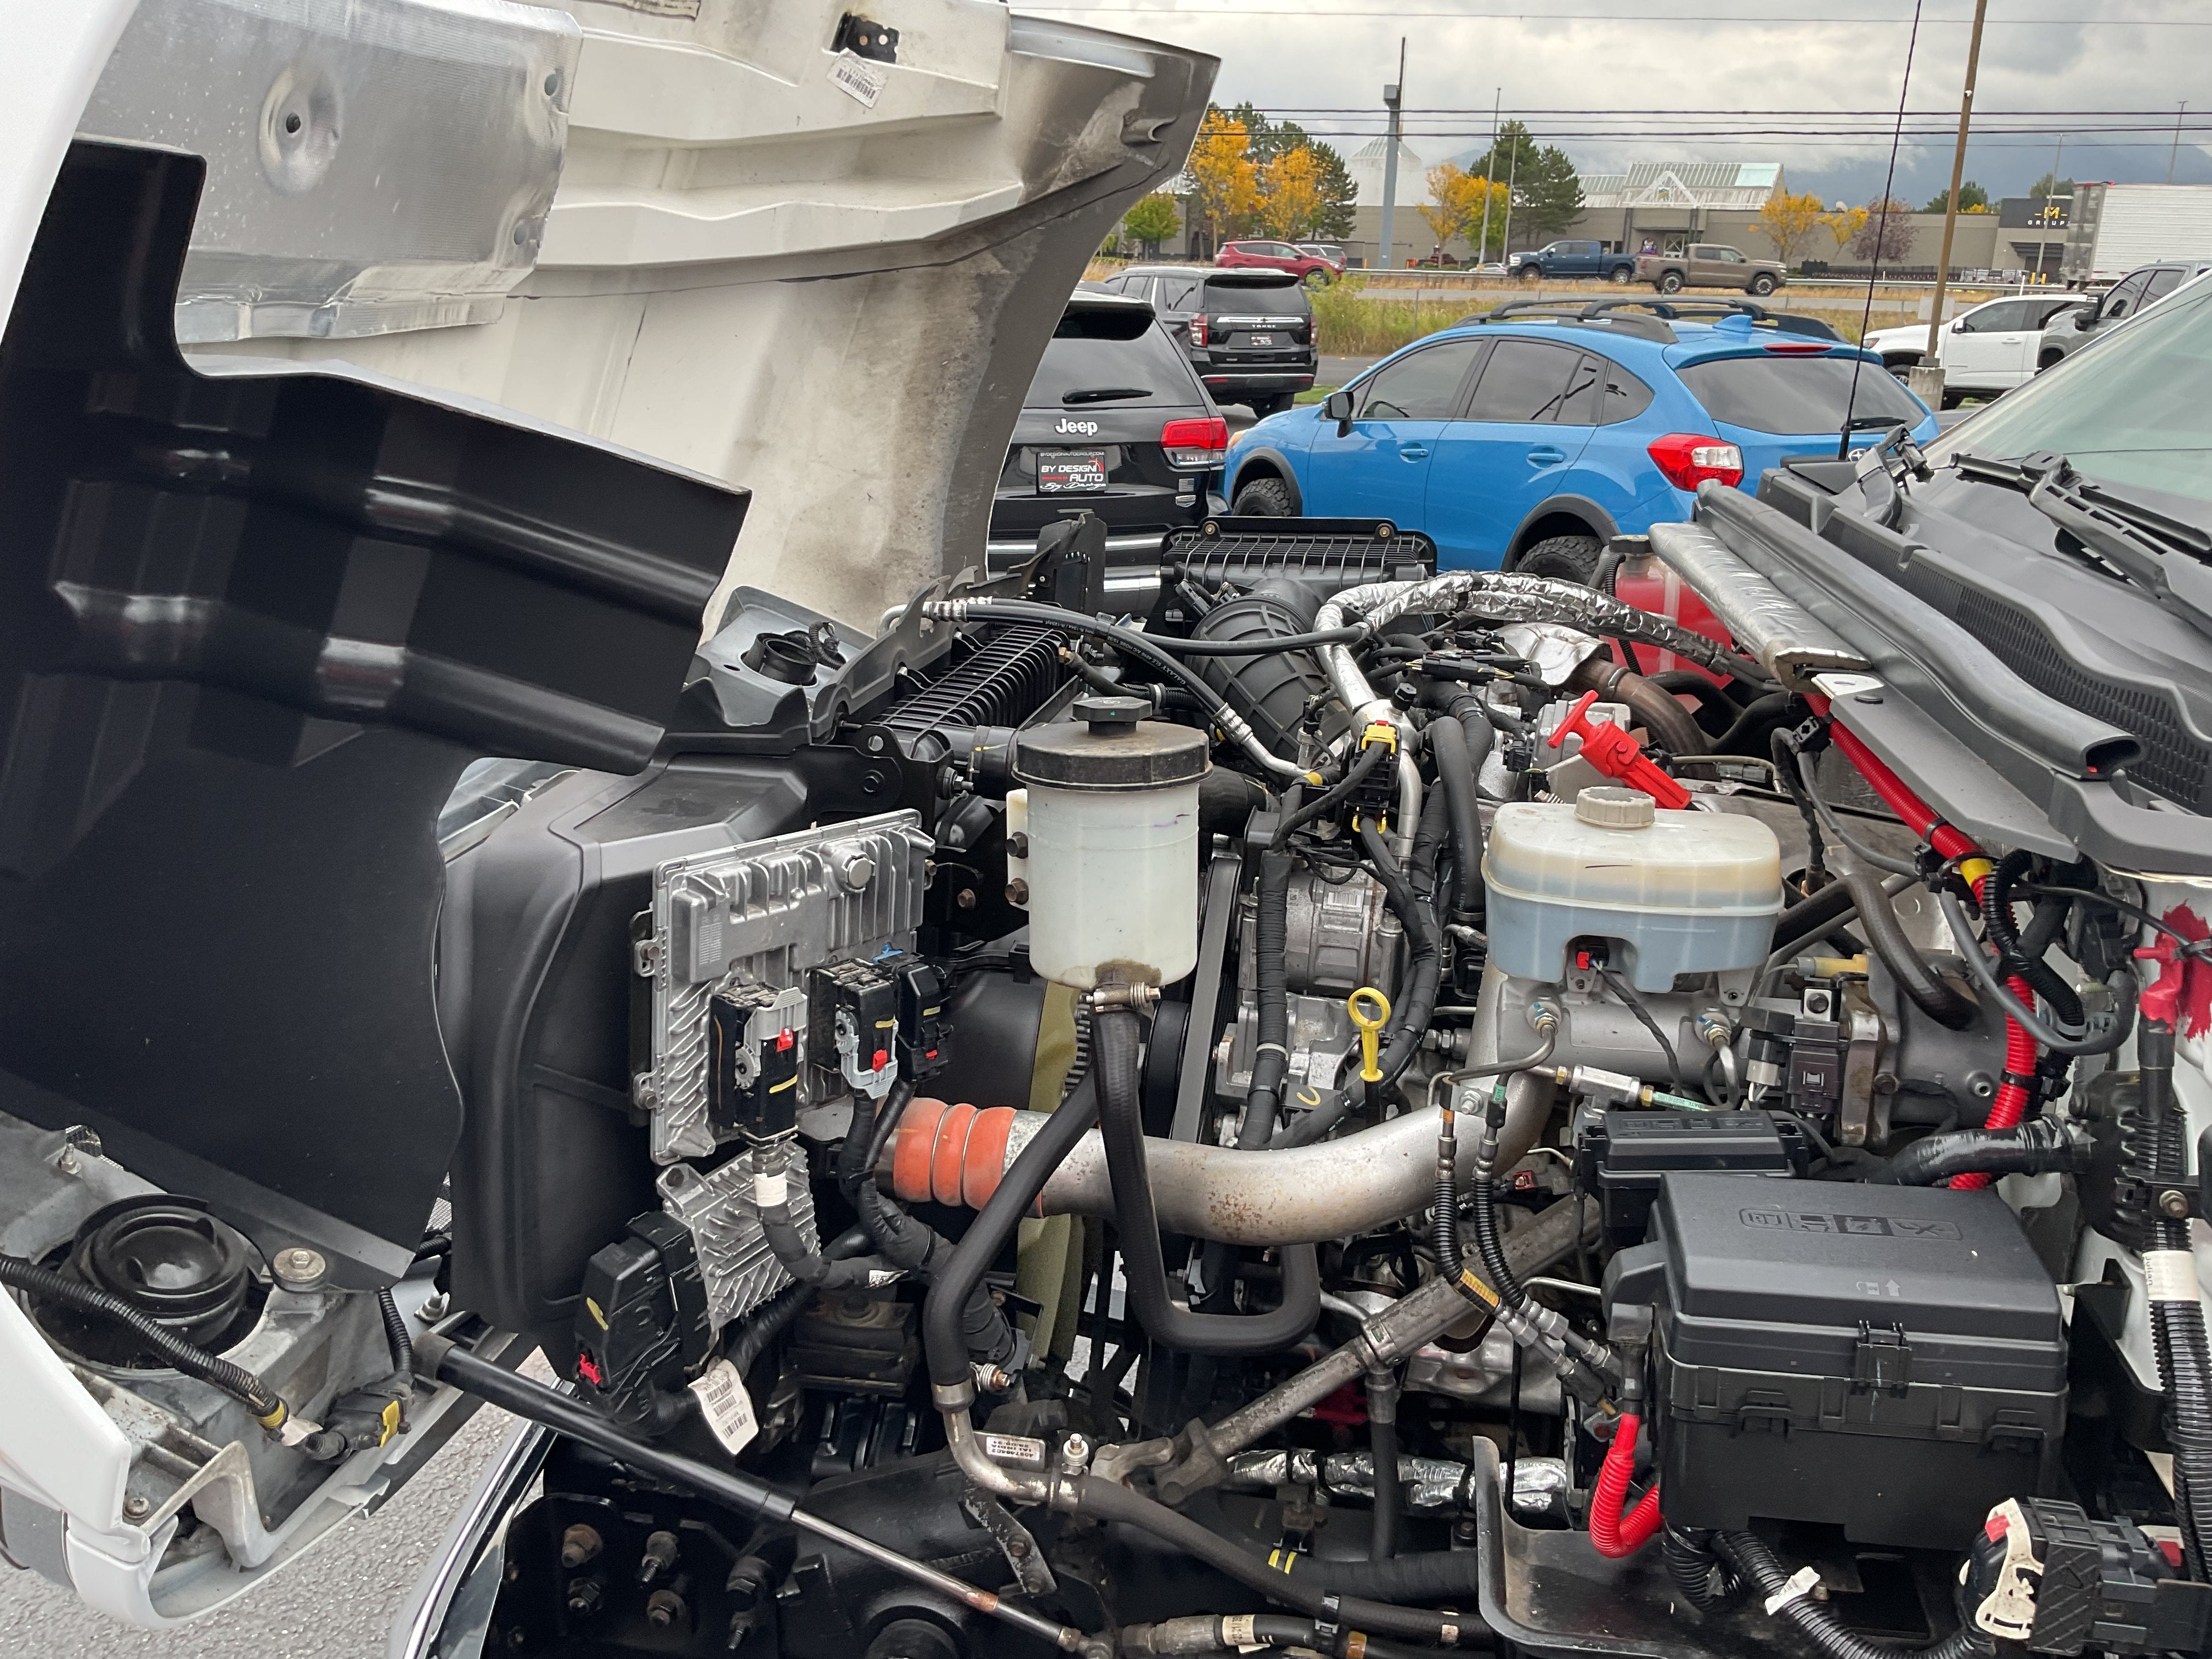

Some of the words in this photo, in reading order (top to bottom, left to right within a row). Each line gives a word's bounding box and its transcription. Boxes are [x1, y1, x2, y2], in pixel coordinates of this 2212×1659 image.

[1055, 417, 1098, 437] Jeep
[1069, 473, 1103, 482] AUTO
[1120, 641, 1133, 650] HOSE
[1152, 658, 1162, 667] SLE
[1163, 665, 1186, 685] GALAXY
